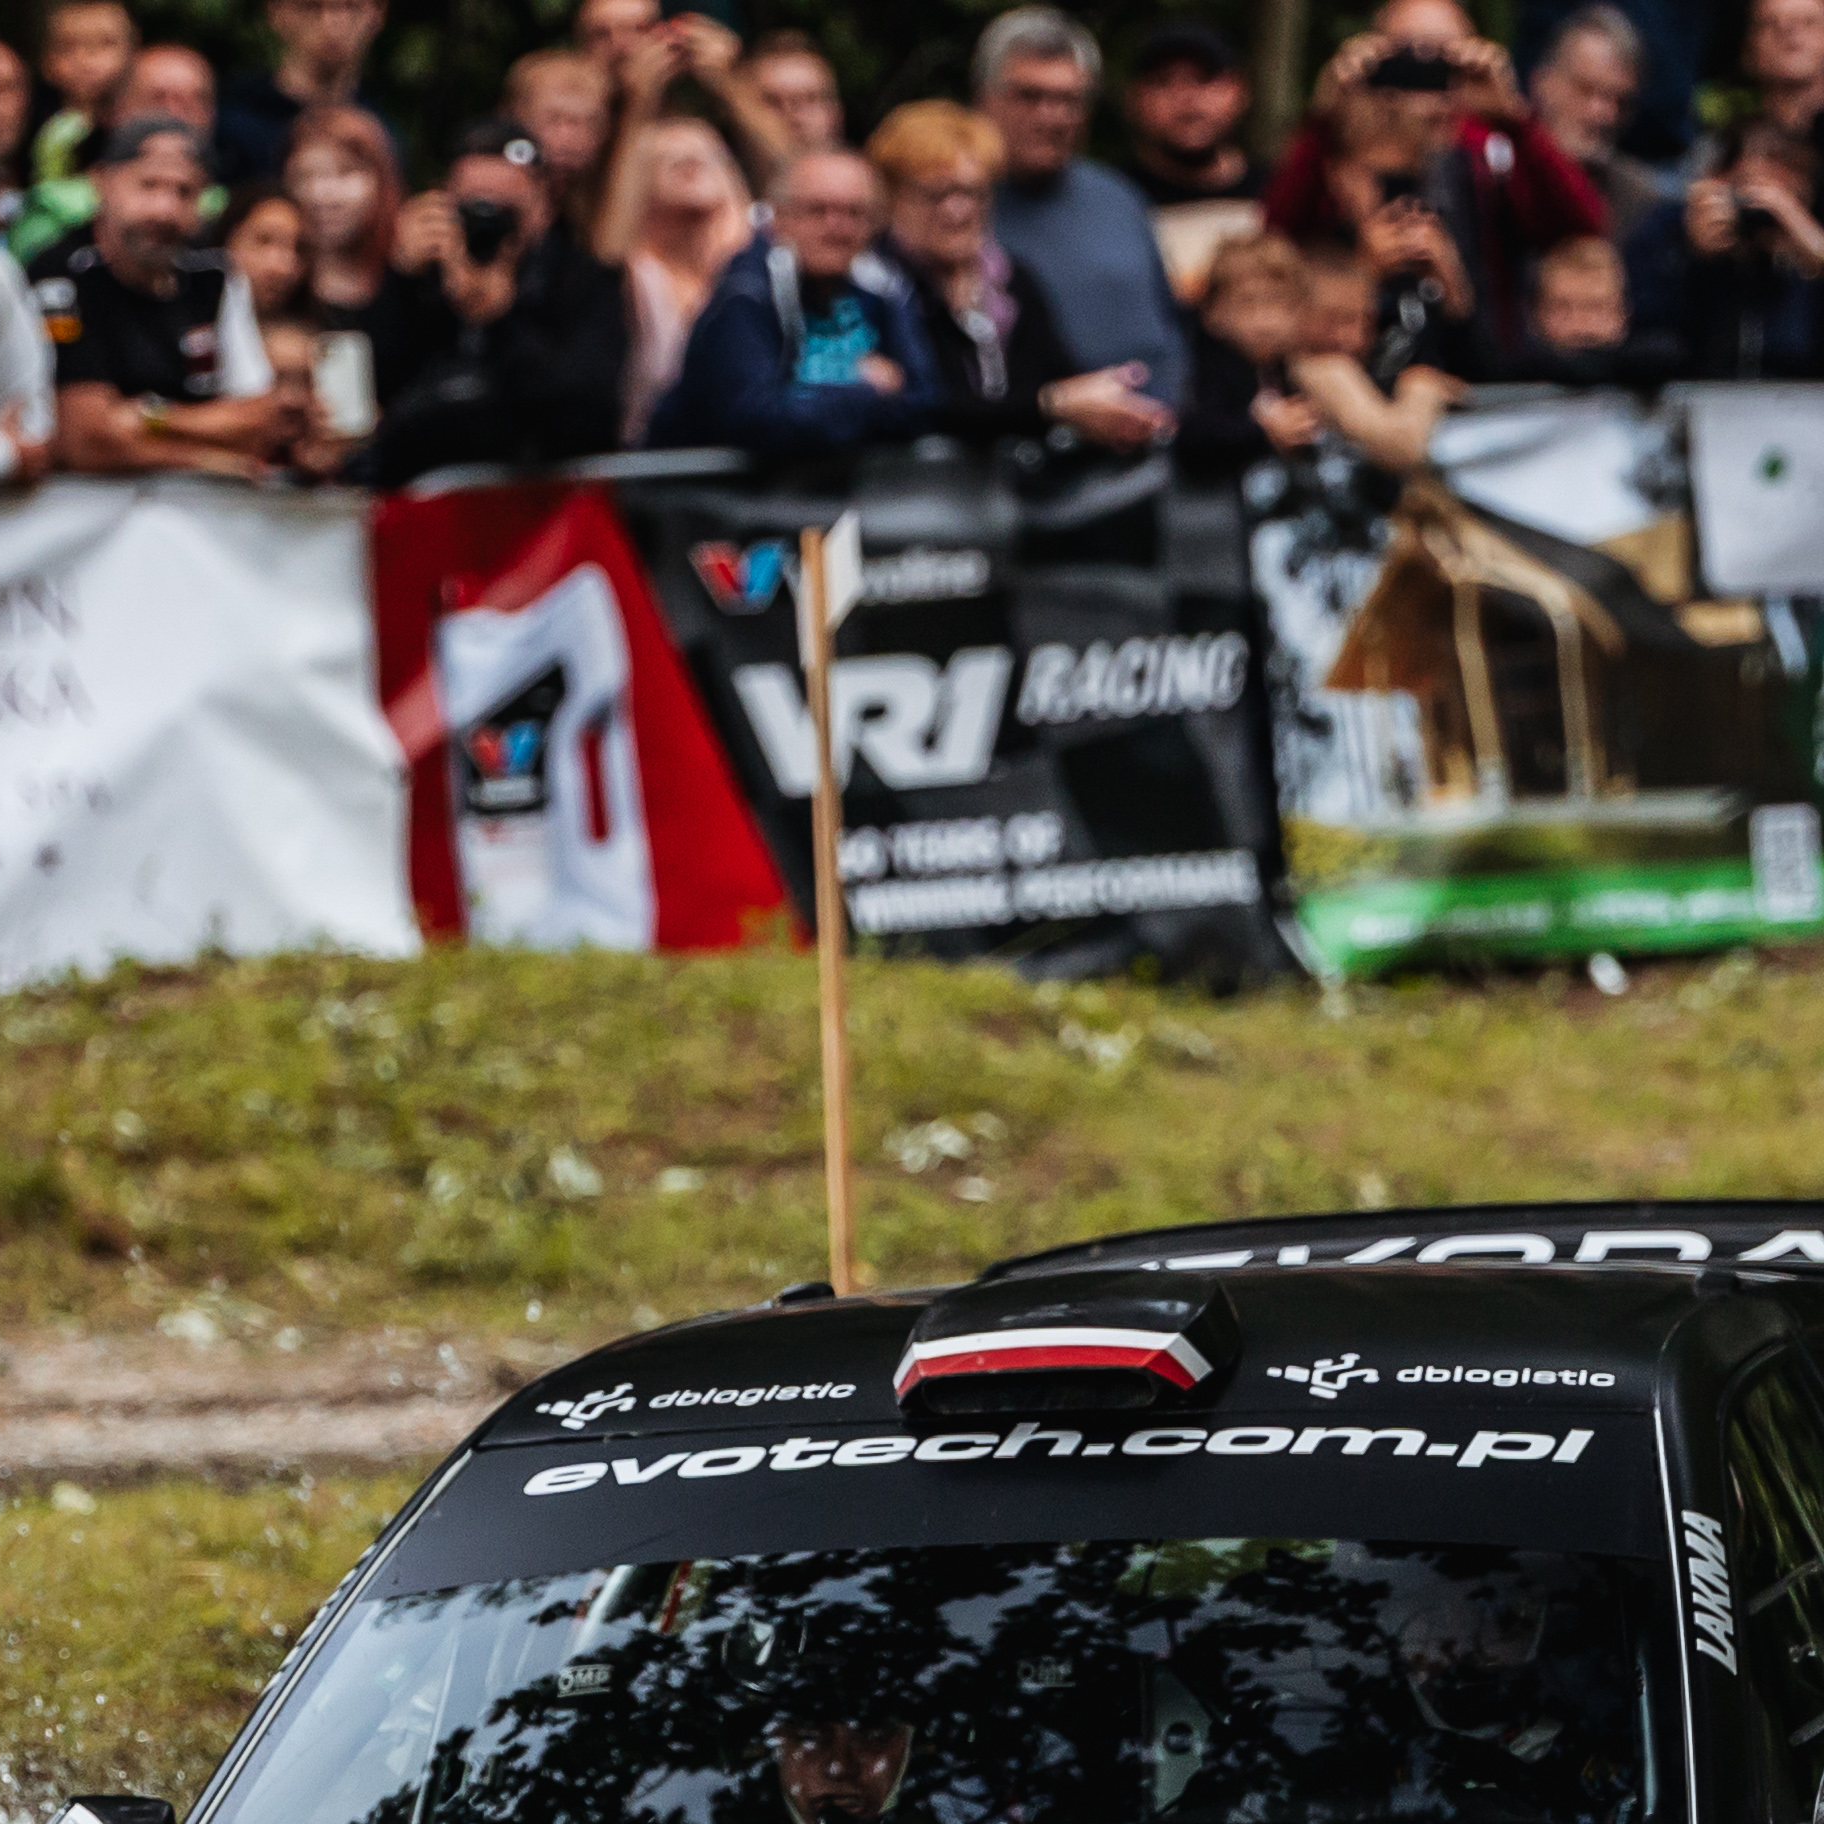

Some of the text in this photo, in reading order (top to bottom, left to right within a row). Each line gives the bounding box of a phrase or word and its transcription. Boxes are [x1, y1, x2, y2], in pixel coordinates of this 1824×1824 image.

[1015, 630, 1250, 726] RACING
[649, 1383, 857, 1411] dblogistic
[1395, 1365, 1616, 1387] dblogistic
[523, 1423, 1596, 1497] evotech.com.pl
[1680, 1509, 1739, 1676] LAKMA
